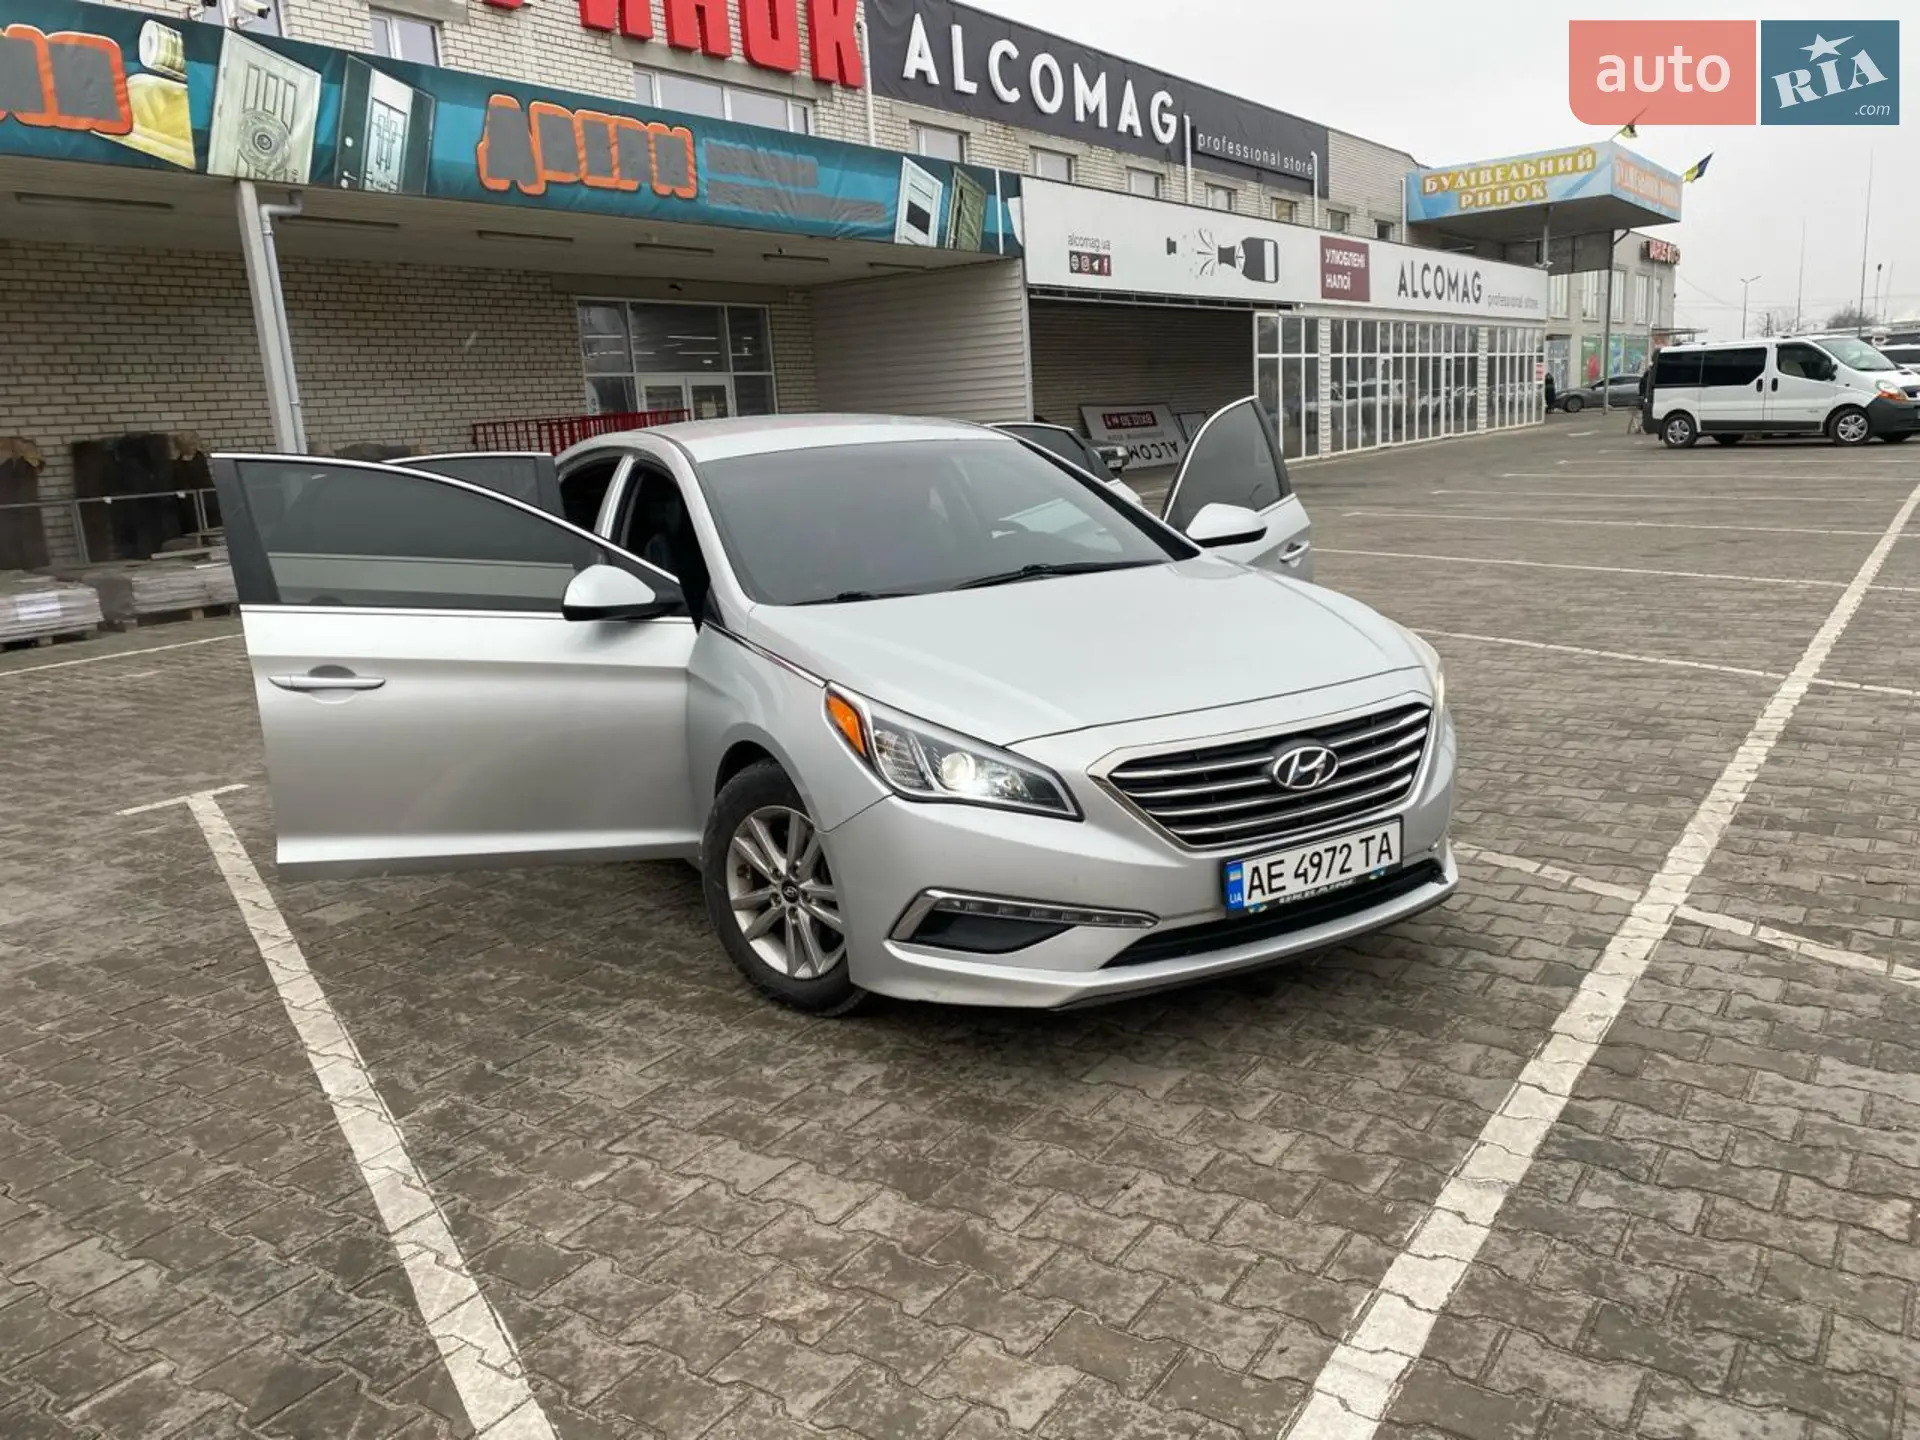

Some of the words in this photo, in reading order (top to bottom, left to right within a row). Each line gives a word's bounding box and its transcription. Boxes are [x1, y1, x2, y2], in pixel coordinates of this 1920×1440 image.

[902, 12, 1177, 144] ALCOMAG
[1197, 133, 1281, 166] professional
[1283, 155, 1313, 175] store
[1424, 149, 1596, 194] БУДІВЕЛЬНИЙ
[1459, 180, 1548, 209] РИНОК
[1325, 271, 1352, 291] НАПОЇ
[1397, 260, 1483, 304] ALCOMAG
[1247, 859, 1286, 900] AE
[1293, 843, 1352, 885] 4972
[1359, 831, 1393, 868] TA
